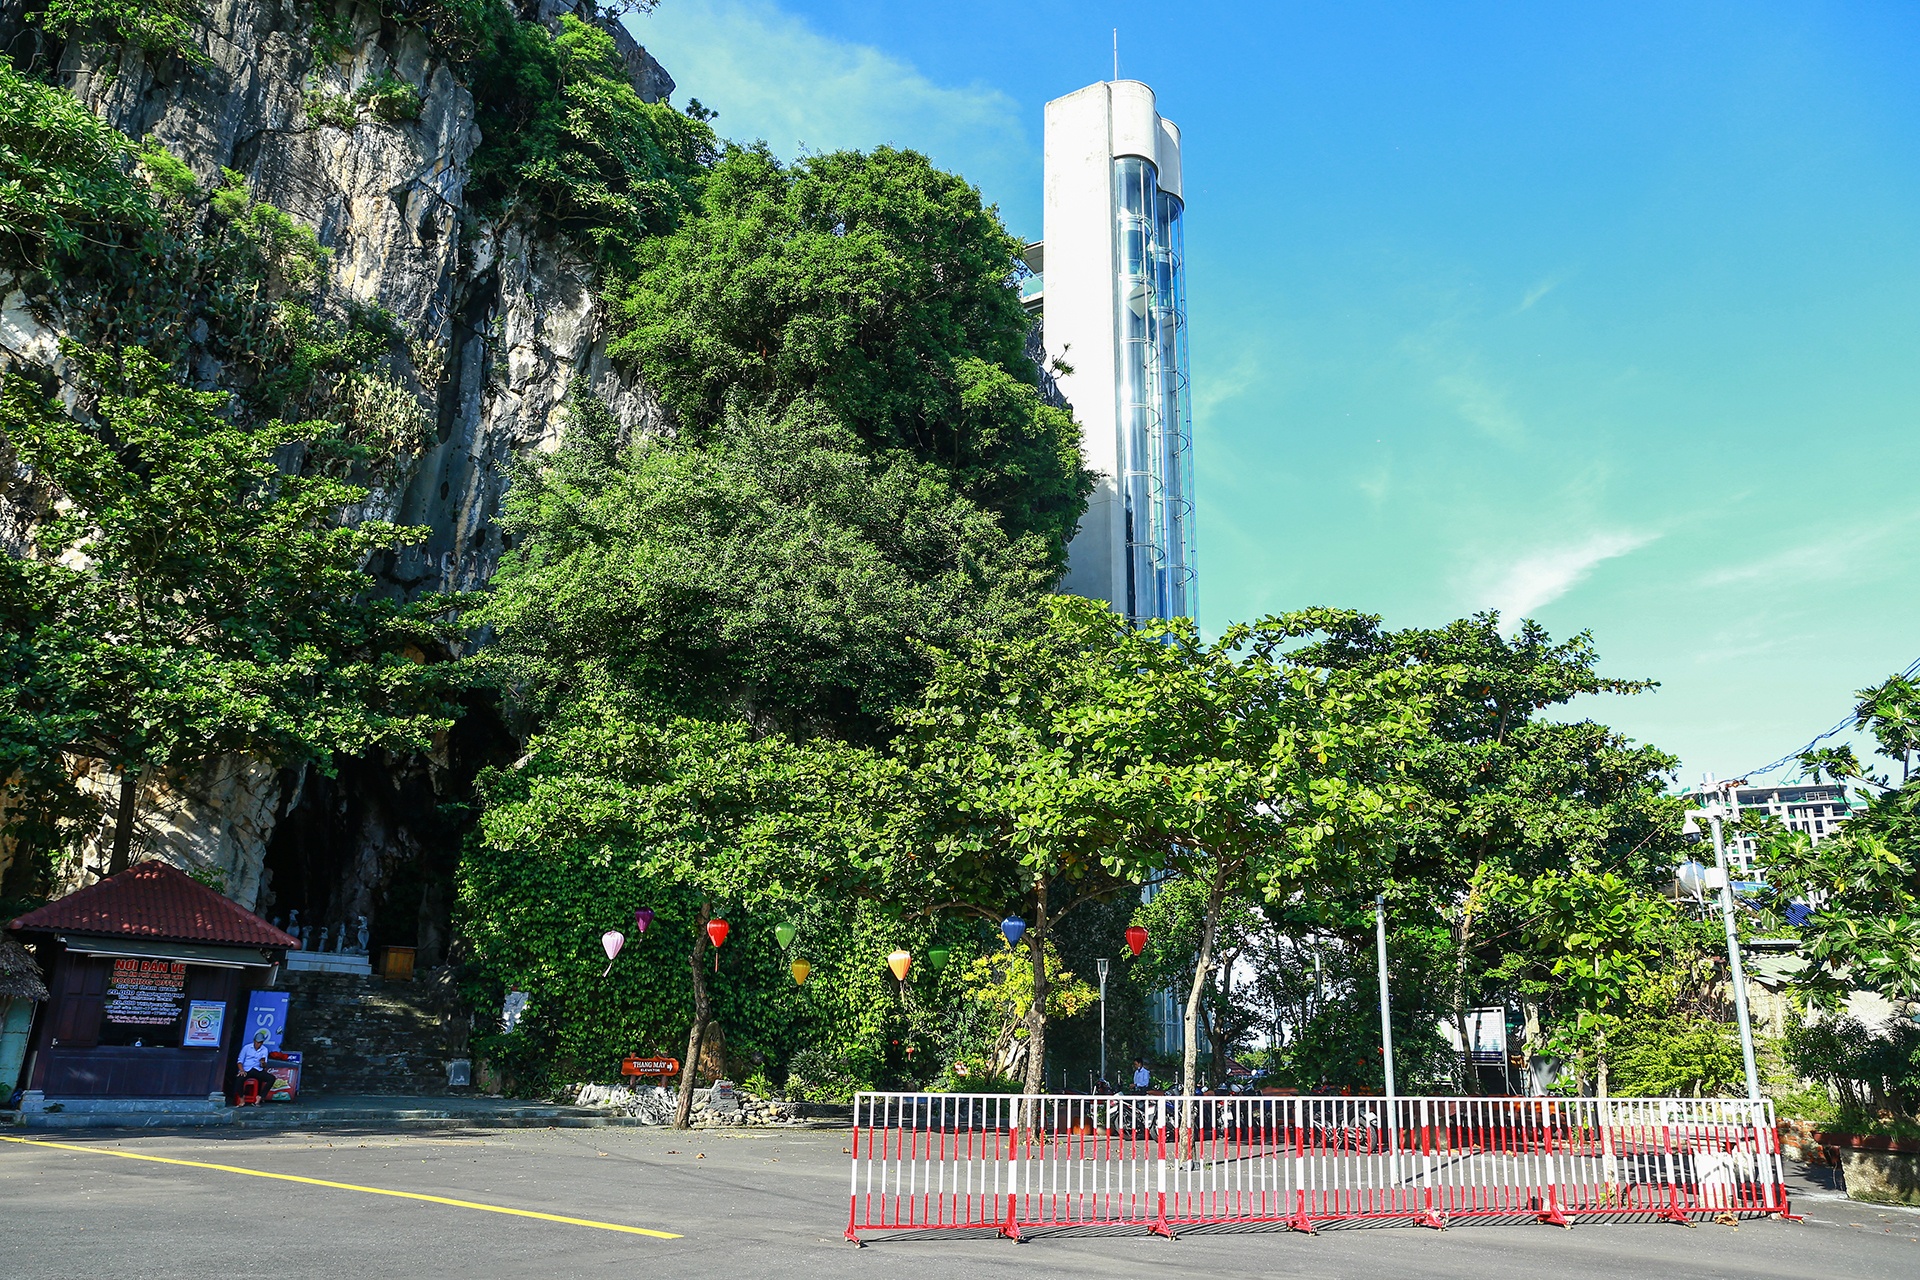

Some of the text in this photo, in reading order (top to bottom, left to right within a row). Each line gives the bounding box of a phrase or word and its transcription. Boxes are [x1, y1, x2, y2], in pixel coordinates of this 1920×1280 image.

[114, 959, 139, 971] NƠI
[140, 960, 168, 972] BÁN
[254, 1007, 275, 1045] psi
